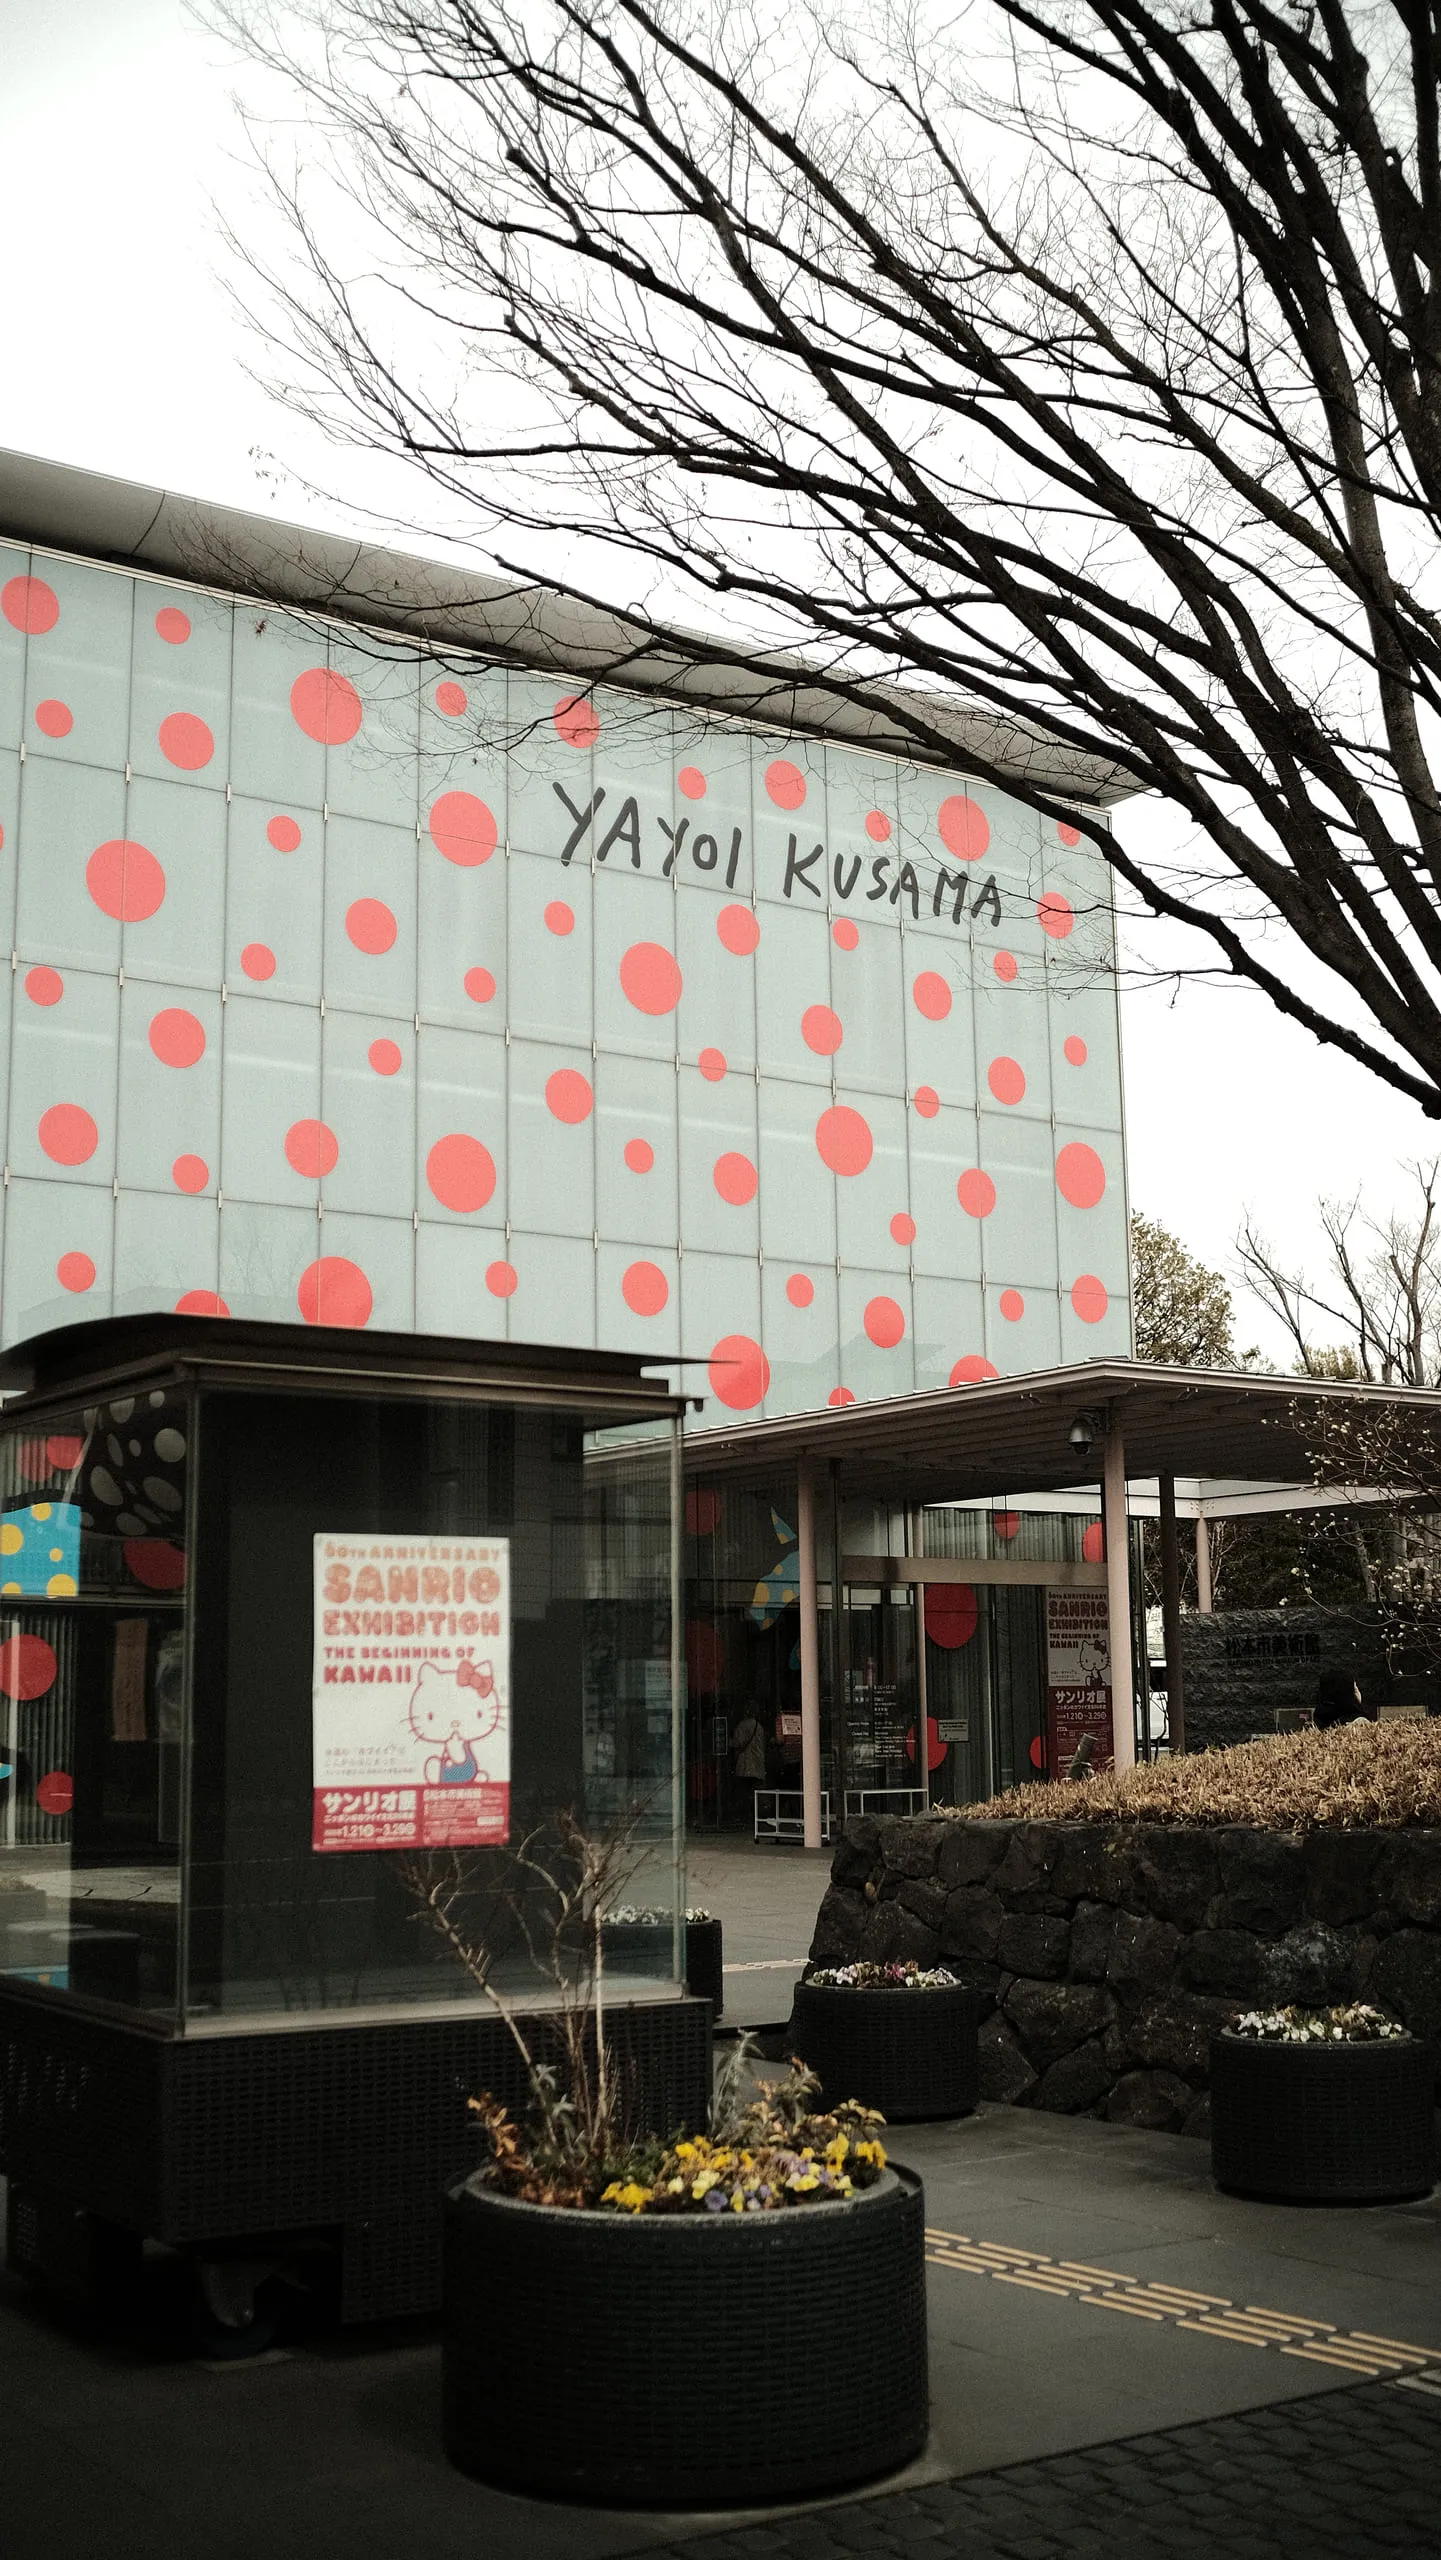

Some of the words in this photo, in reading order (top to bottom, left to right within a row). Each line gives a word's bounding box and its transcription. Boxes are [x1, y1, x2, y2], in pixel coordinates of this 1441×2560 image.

[552, 781, 743, 889] YAYOI
[783, 832, 1004, 928] KUSAMA
[369, 1545, 500, 1561] ANNIVERSARY
[322, 1562, 501, 1604] SANRIO
[1048, 1600, 1108, 1617] SANRIO
[322, 1609, 500, 1637] EXHIBITION
[1048, 1618, 1108, 1630] EXHIBITION
[324, 1646, 355, 1659] THE
[361, 1646, 451, 1659] BEGINNING
[456, 1646, 475, 1659] OF
[1049, 1640, 1079, 1649] KAWAII
[323, 1664, 412, 1684] KAWAII
[1055, 1690, 1107, 1704] サンリオ展
[322, 1790, 417, 1814] サンリオ展
